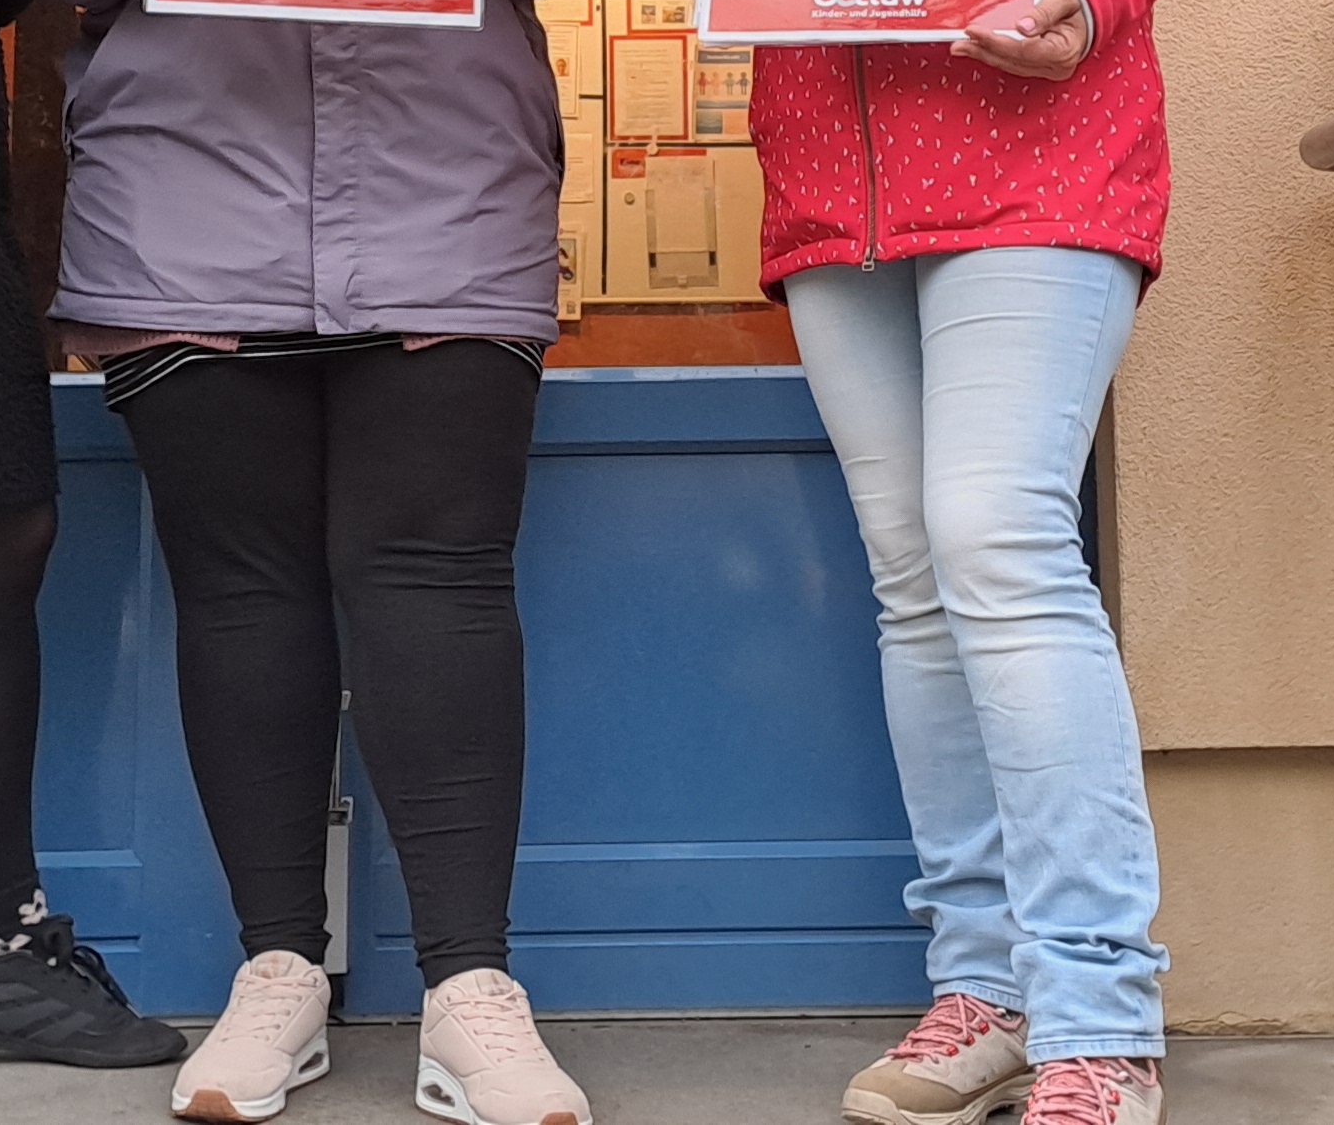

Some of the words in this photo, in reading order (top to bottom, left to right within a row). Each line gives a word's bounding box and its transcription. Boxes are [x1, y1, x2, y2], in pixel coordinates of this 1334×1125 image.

[811, 9, 848, 18] Kinder-
[849, 9, 867, 18] und
[869, 8, 928, 19] Jugendhilfe
